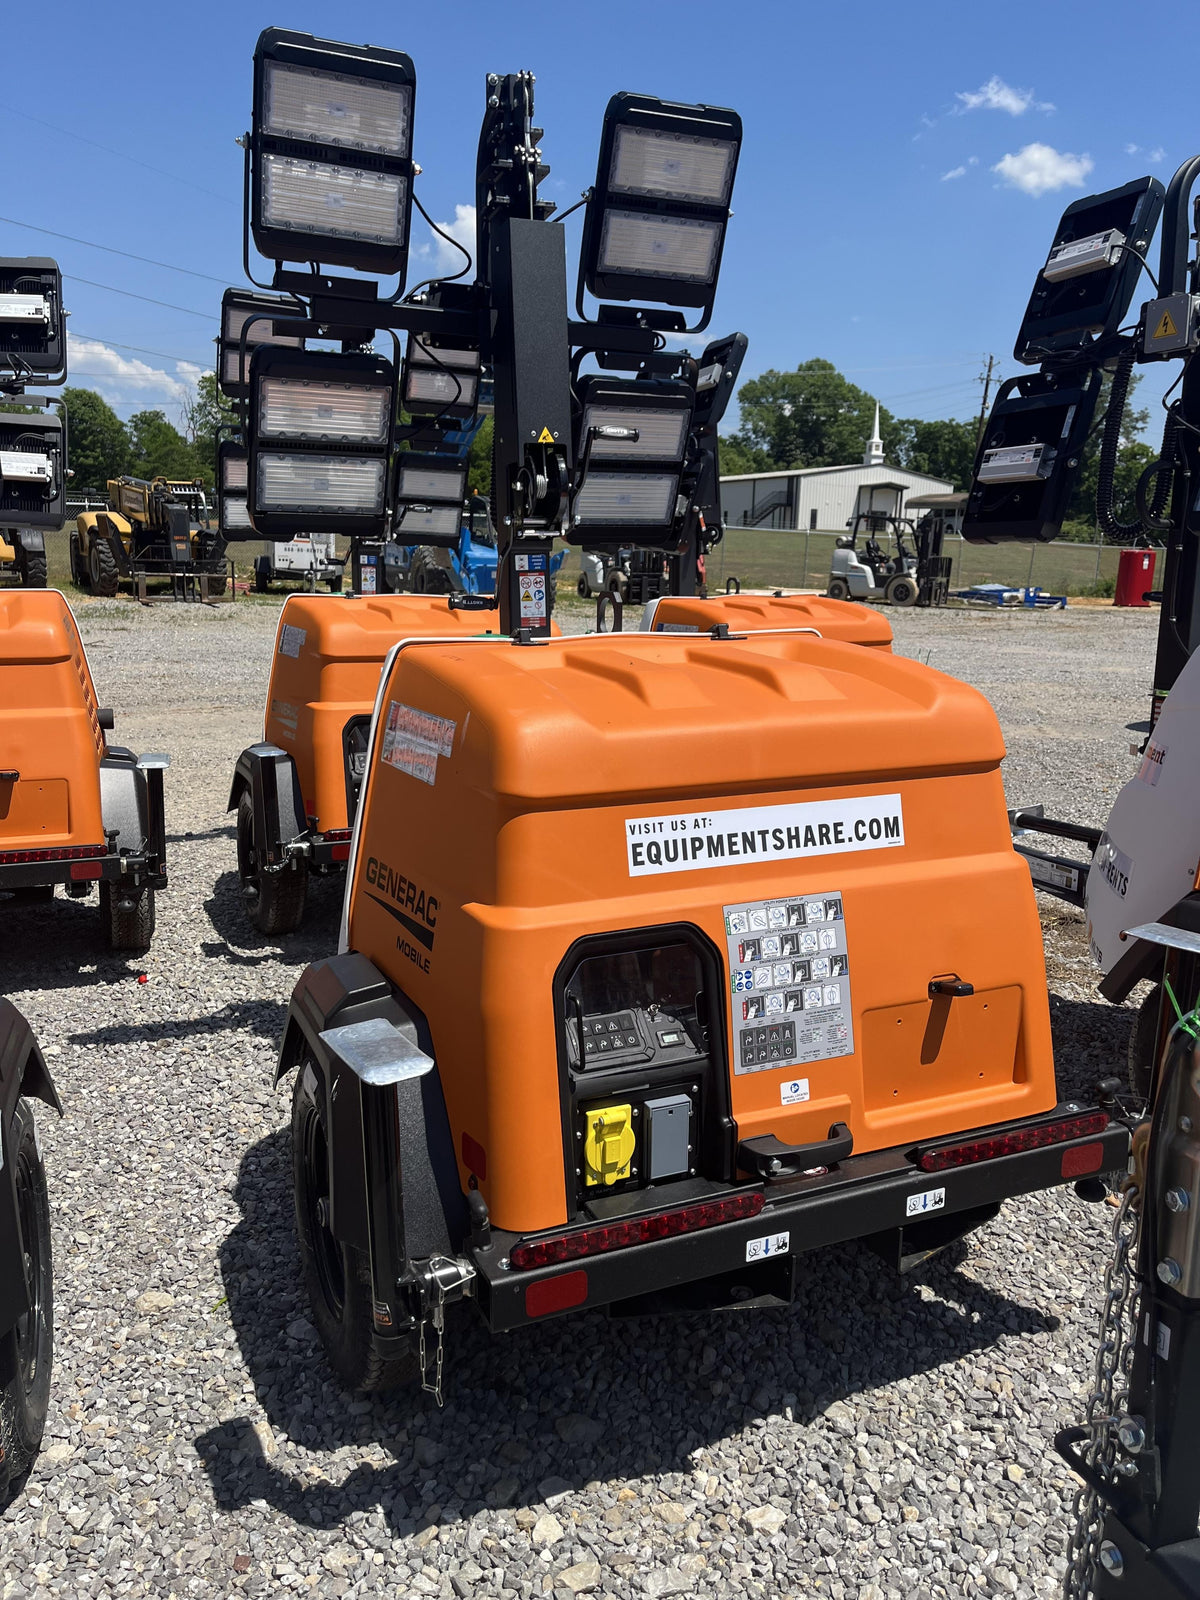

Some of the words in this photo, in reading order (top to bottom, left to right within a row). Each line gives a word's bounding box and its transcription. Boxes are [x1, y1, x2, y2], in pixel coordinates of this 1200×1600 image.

[629, 821, 665, 836] VISIT
[671, 819, 687, 832] US
[693, 817, 713, 830] AT:
[631, 815, 900, 867] EQUIPMENTSHARE.COM
[365, 857, 438, 928] GENERAC
[396, 935, 431, 974] MOBILE
